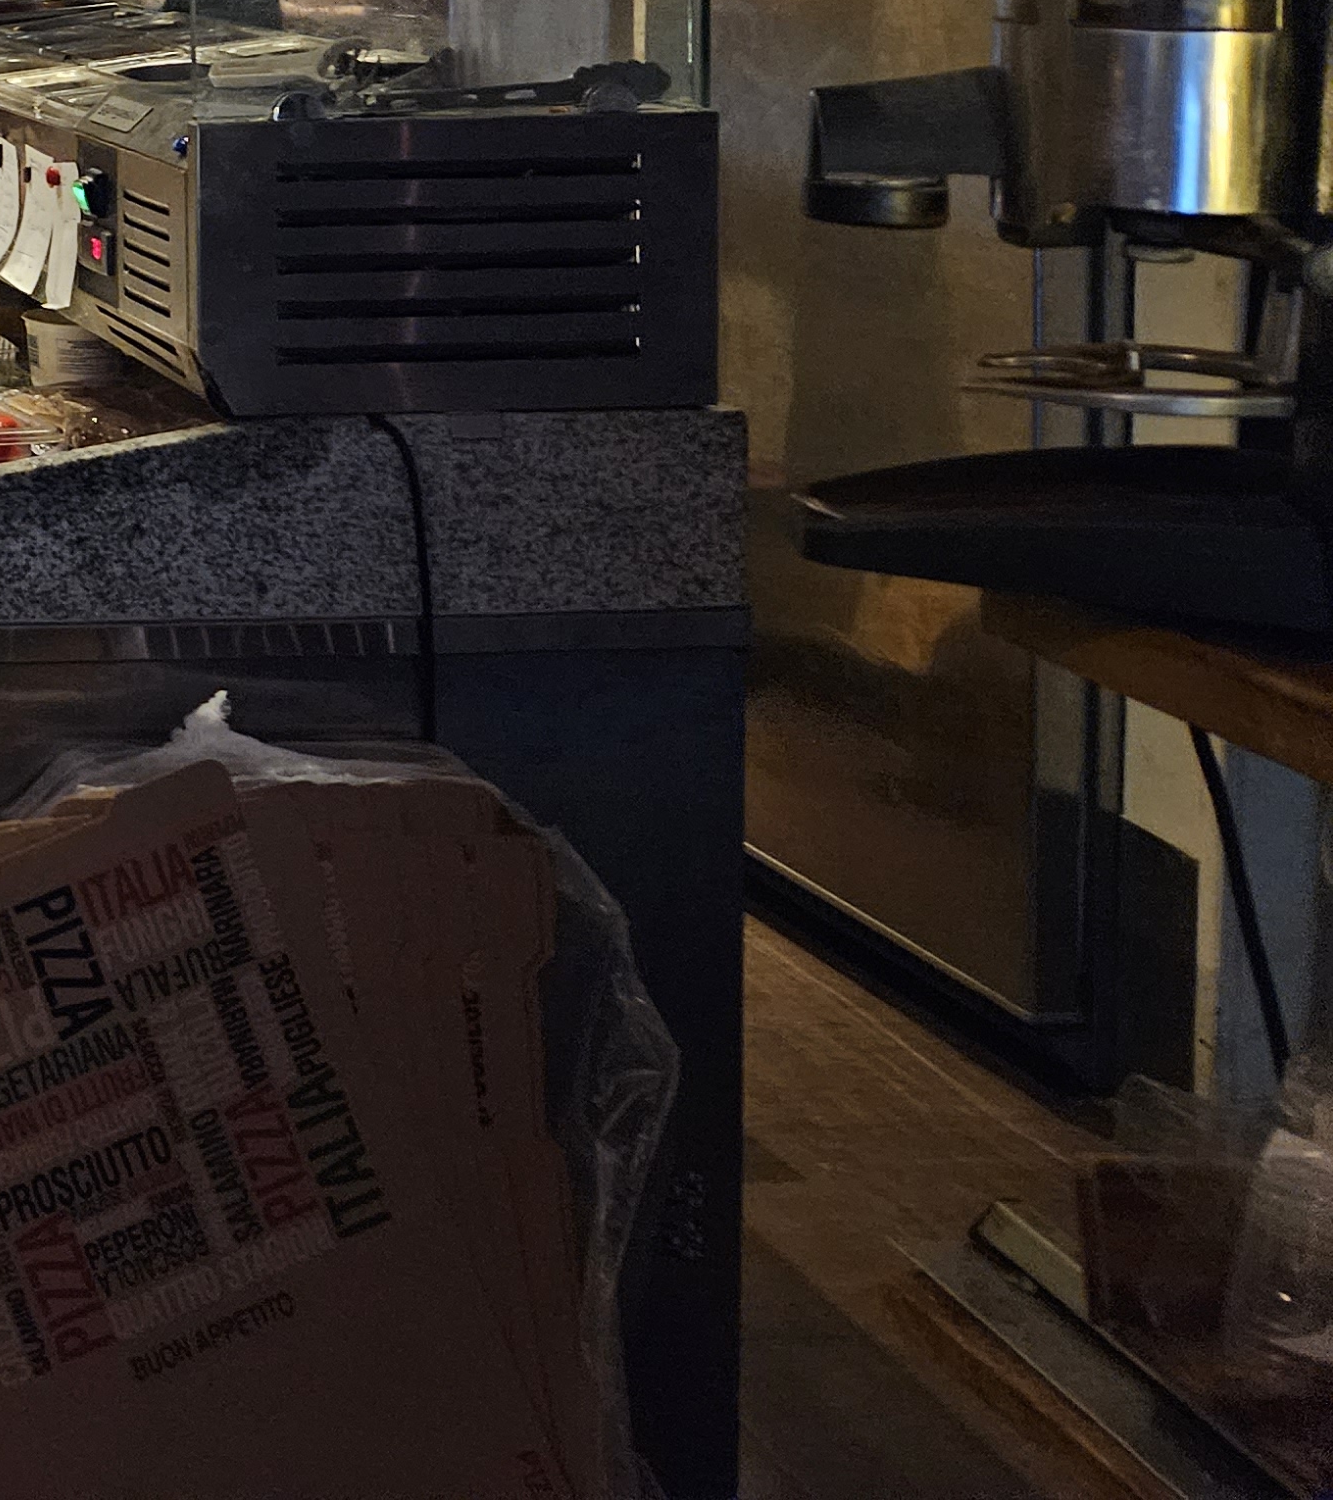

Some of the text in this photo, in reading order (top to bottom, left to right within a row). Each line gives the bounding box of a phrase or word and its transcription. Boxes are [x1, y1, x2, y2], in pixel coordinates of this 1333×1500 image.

[78, 844, 197, 927] ITALIA
[191, 846, 255, 968] MARINARA
[14, 885, 114, 1041] PIZZA
[114, 939, 227, 1012] BUFALA
[259, 953, 328, 1076] PUGLIESE
[190, 1108, 263, 1244] SALAMINO
[224, 1083, 322, 1228] PIZZA
[287, 1064, 391, 1238] ITALIA
[15, 1209, 118, 1362] PIZZA
[83, 1203, 199, 1270] PEPERONI
[95, 1231, 209, 1297] BOSCAIOLA
[129, 1291, 294, 1381] BUON APPETITO
